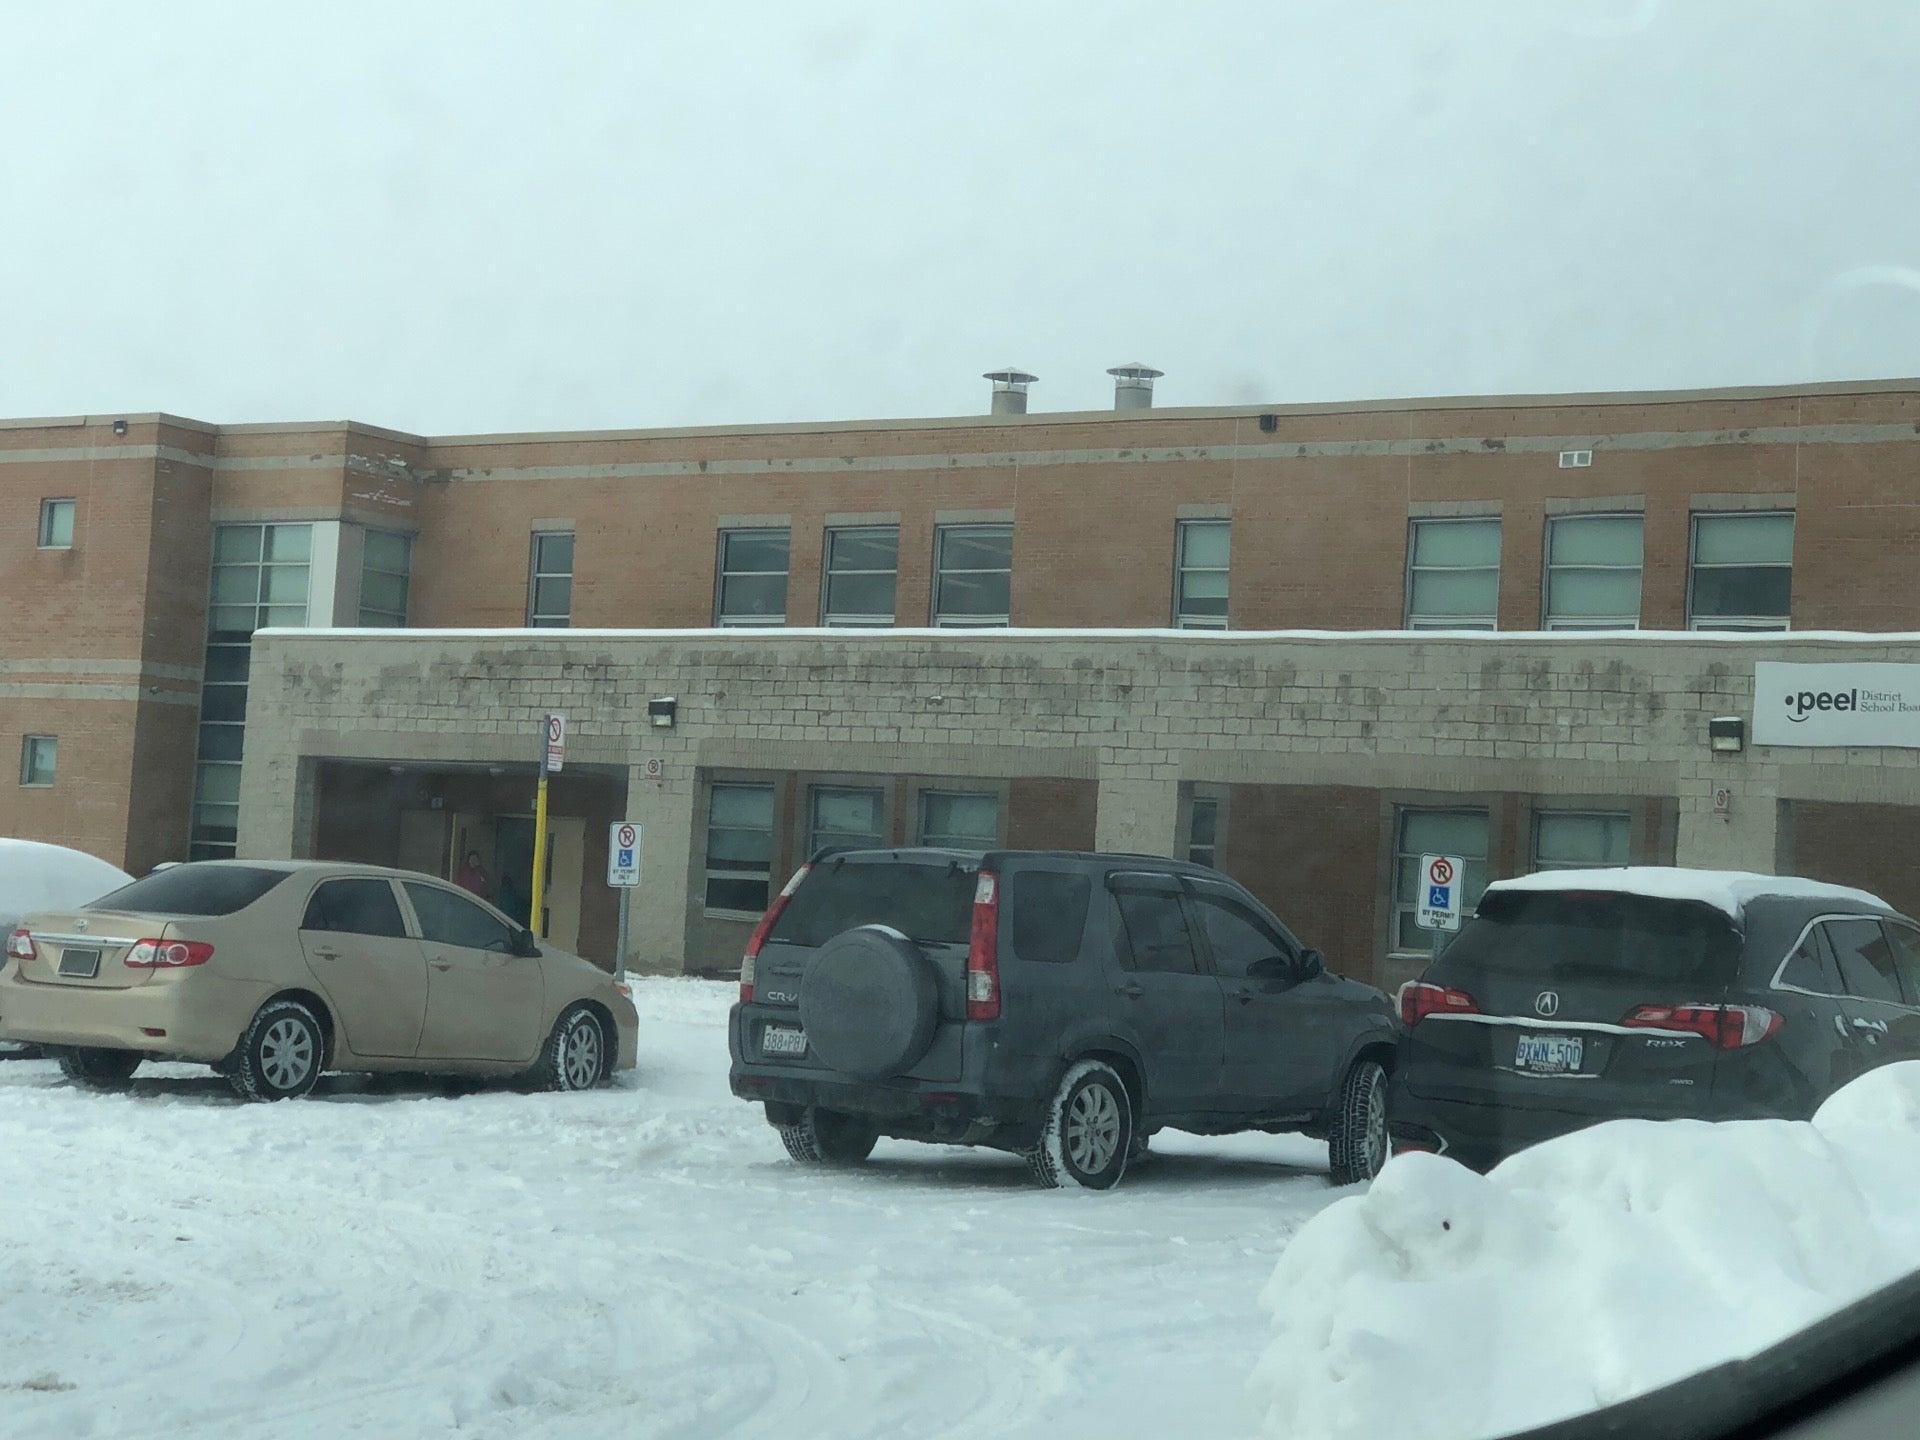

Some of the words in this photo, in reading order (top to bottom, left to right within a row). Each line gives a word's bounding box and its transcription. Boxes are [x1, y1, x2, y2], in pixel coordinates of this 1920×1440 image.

[1861, 690, 1902, 701] District
[1797, 688, 1858, 715] peel
[1860, 701, 1895, 712] School
[1432, 910, 1455, 920] PERMIT
[1430, 917, 1447, 926] ONLY
[767, 991, 798, 1002] CR-V
